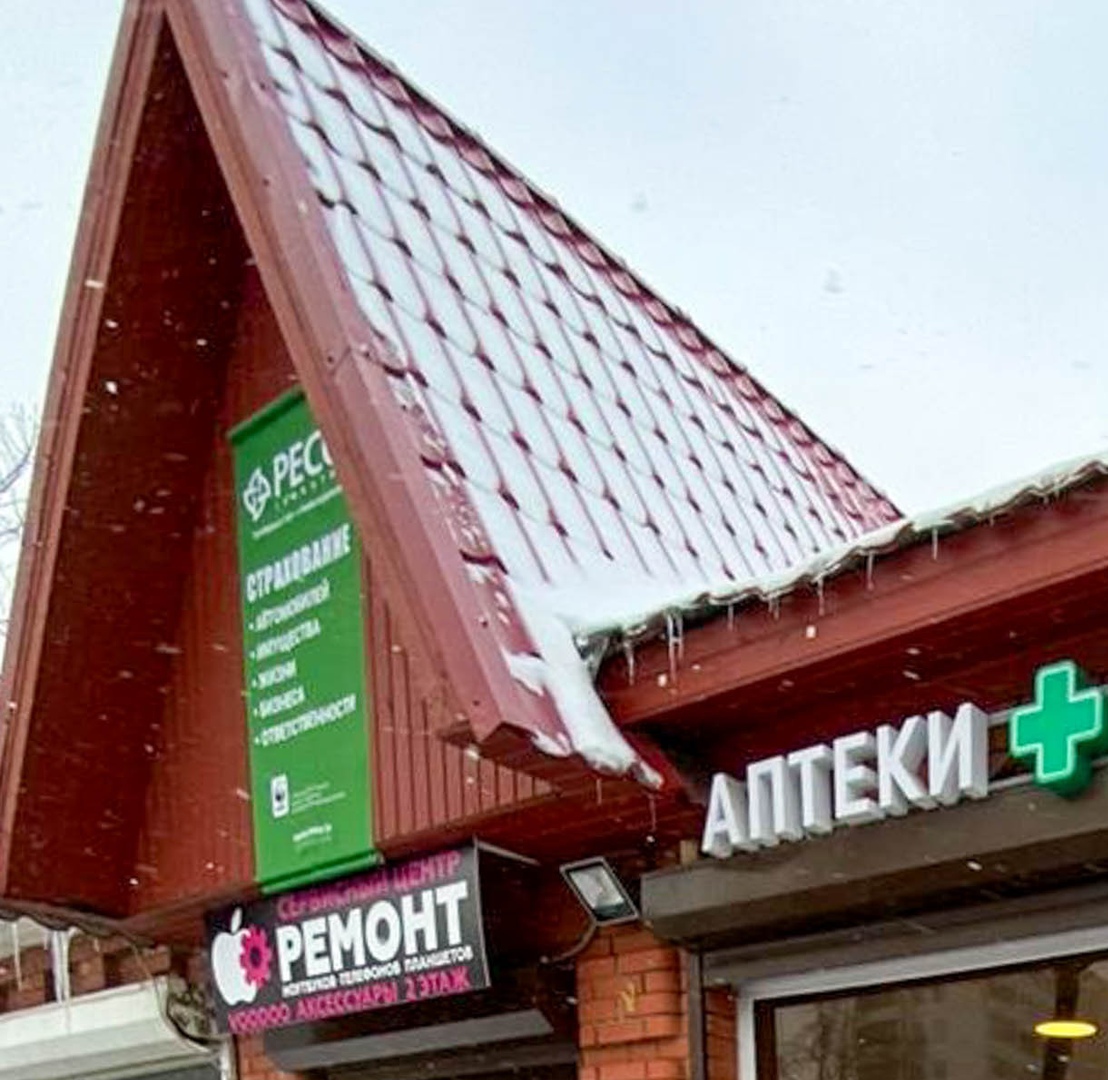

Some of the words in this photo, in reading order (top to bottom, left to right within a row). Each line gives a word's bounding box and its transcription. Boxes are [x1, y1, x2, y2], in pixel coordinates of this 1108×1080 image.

[246, 522, 351, 603] СТРАХОВАНИЕ
[701, 702, 988, 857] АПТЕКИ
[393, 850, 462, 895] ЦЕНТР
[275, 880, 468, 982] РЕМОНТ
[295, 982, 398, 1021] АКСЕССУАРЫ
[405, 976, 418, 1003] 2
[419, 966, 471, 999] ЭТАЖ
